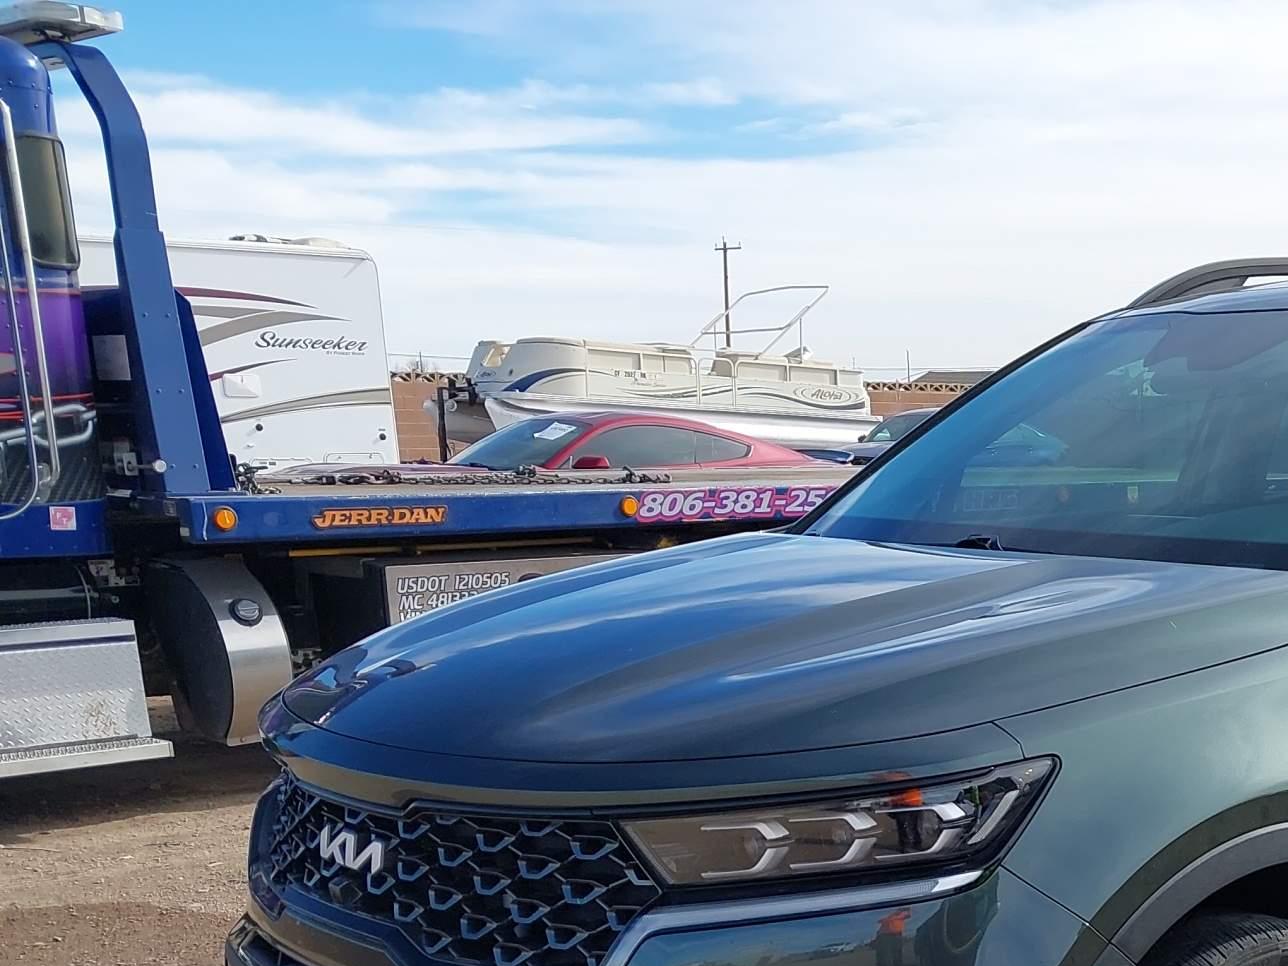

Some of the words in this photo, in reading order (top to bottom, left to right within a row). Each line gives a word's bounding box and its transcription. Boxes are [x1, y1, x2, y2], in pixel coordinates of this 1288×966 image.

[255, 330, 368, 351] Sunseeker
[397, 576, 449, 593] USDOT
[455, 572, 511, 590] 1210505
[400, 594, 424, 610] MC
